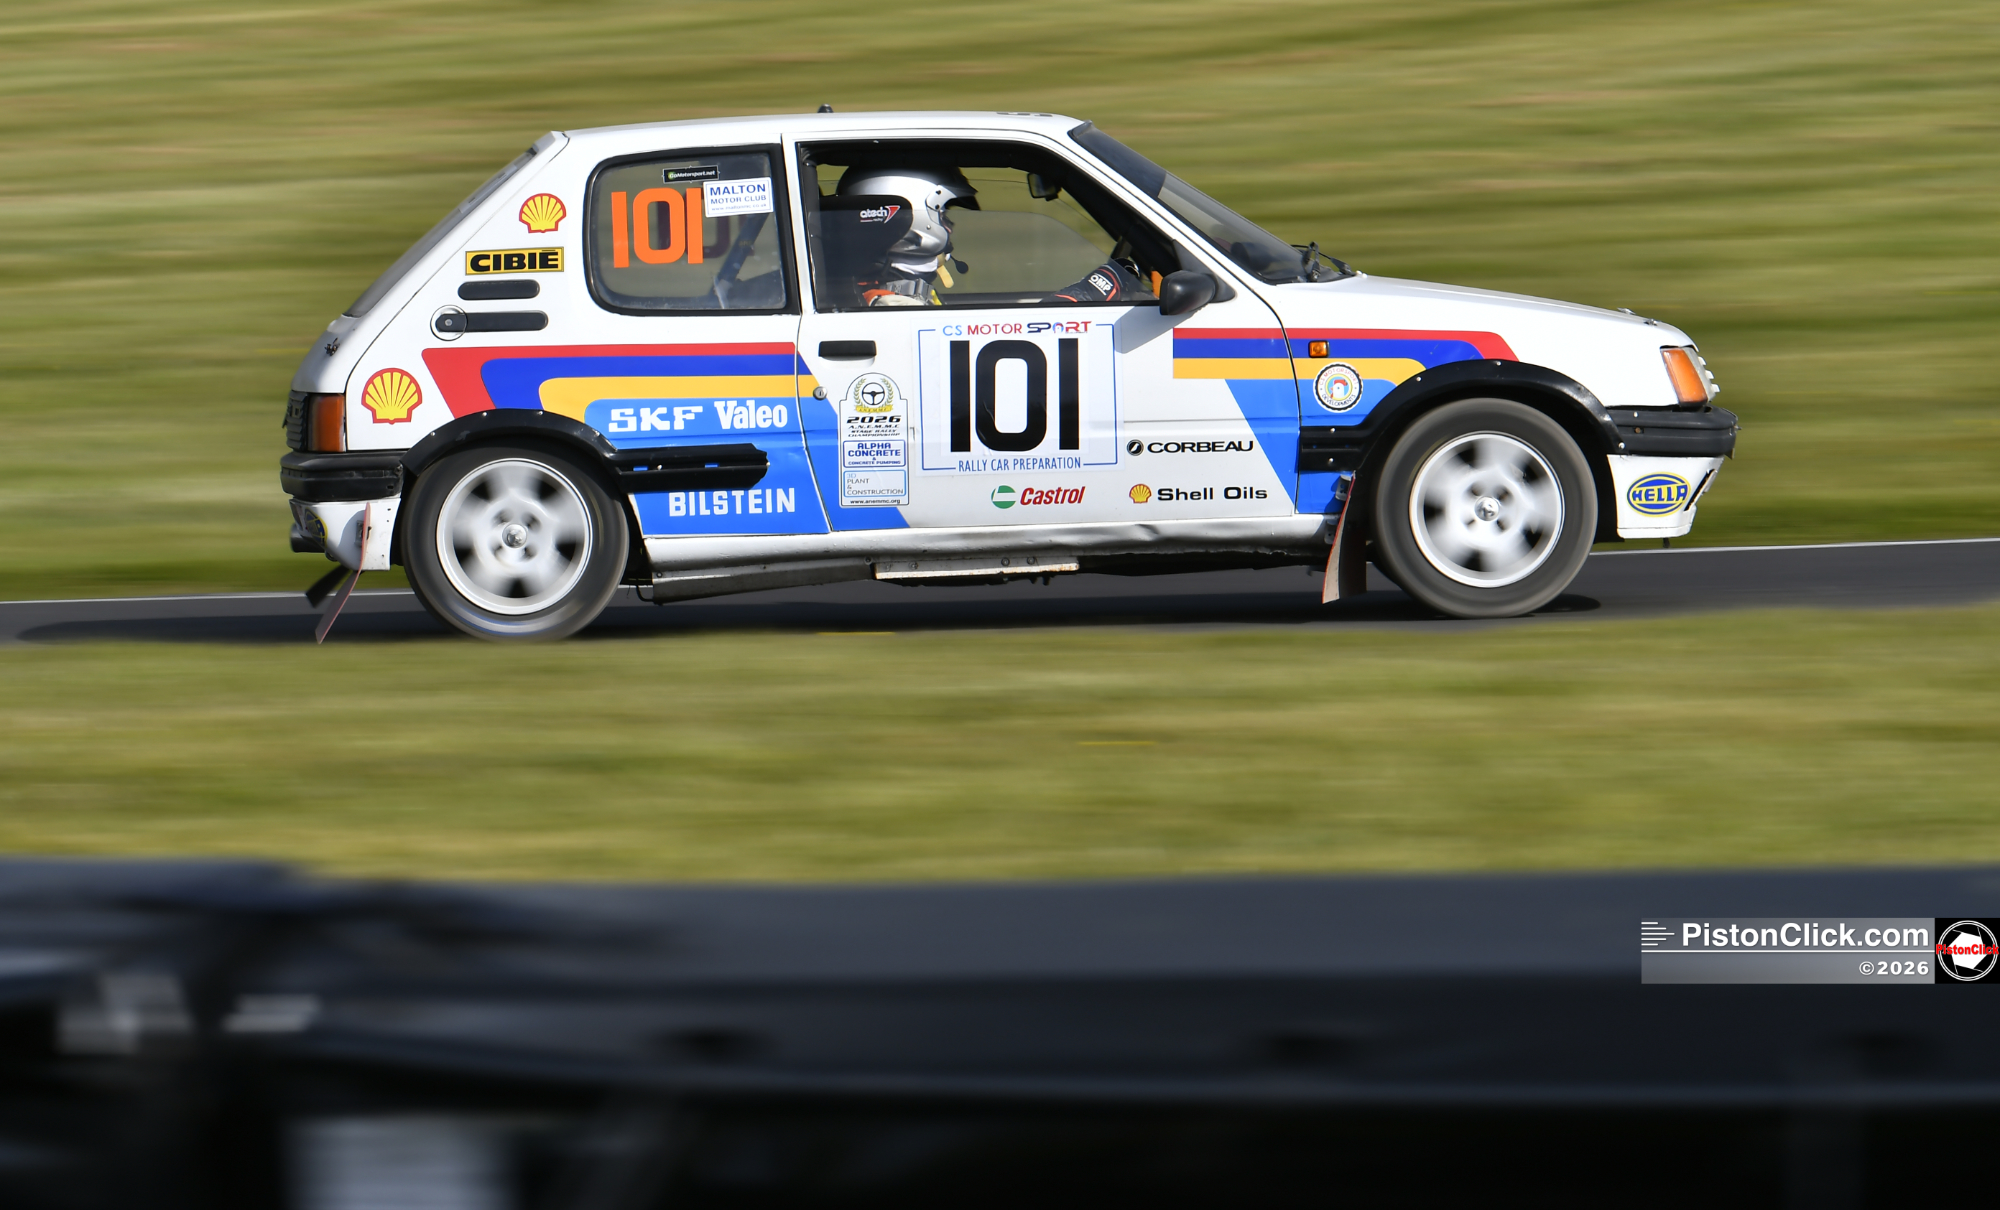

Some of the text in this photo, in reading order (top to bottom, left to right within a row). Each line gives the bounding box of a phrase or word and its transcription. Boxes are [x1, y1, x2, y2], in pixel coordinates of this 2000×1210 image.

[710, 183, 766, 196] MALTON
[710, 195, 766, 205] MOTOR CLUB
[611, 187, 703, 268] 101
[1090, 274, 1112, 291] OMP
[942, 325, 963, 336] CS
[967, 323, 1023, 336] MOTOR
[950, 338, 1080, 452] 101
[608, 399, 788, 432] SKF Valeo
[846, 415, 902, 424] 2026
[848, 449, 901, 457] CONCRETE
[857, 442, 891, 450] ALPHA
[1147, 440, 1254, 454] CORBEAU
[958, 456, 1081, 473] RALLY CAR PREPARATION
[846, 488, 904, 496] CONSTRUCTION
[1020, 486, 1086, 506] Castrol
[1157, 486, 1268, 501] Shell Oils
[1631, 484, 1688, 502] HELLA
[669, 487, 796, 517] BILSTEIN
